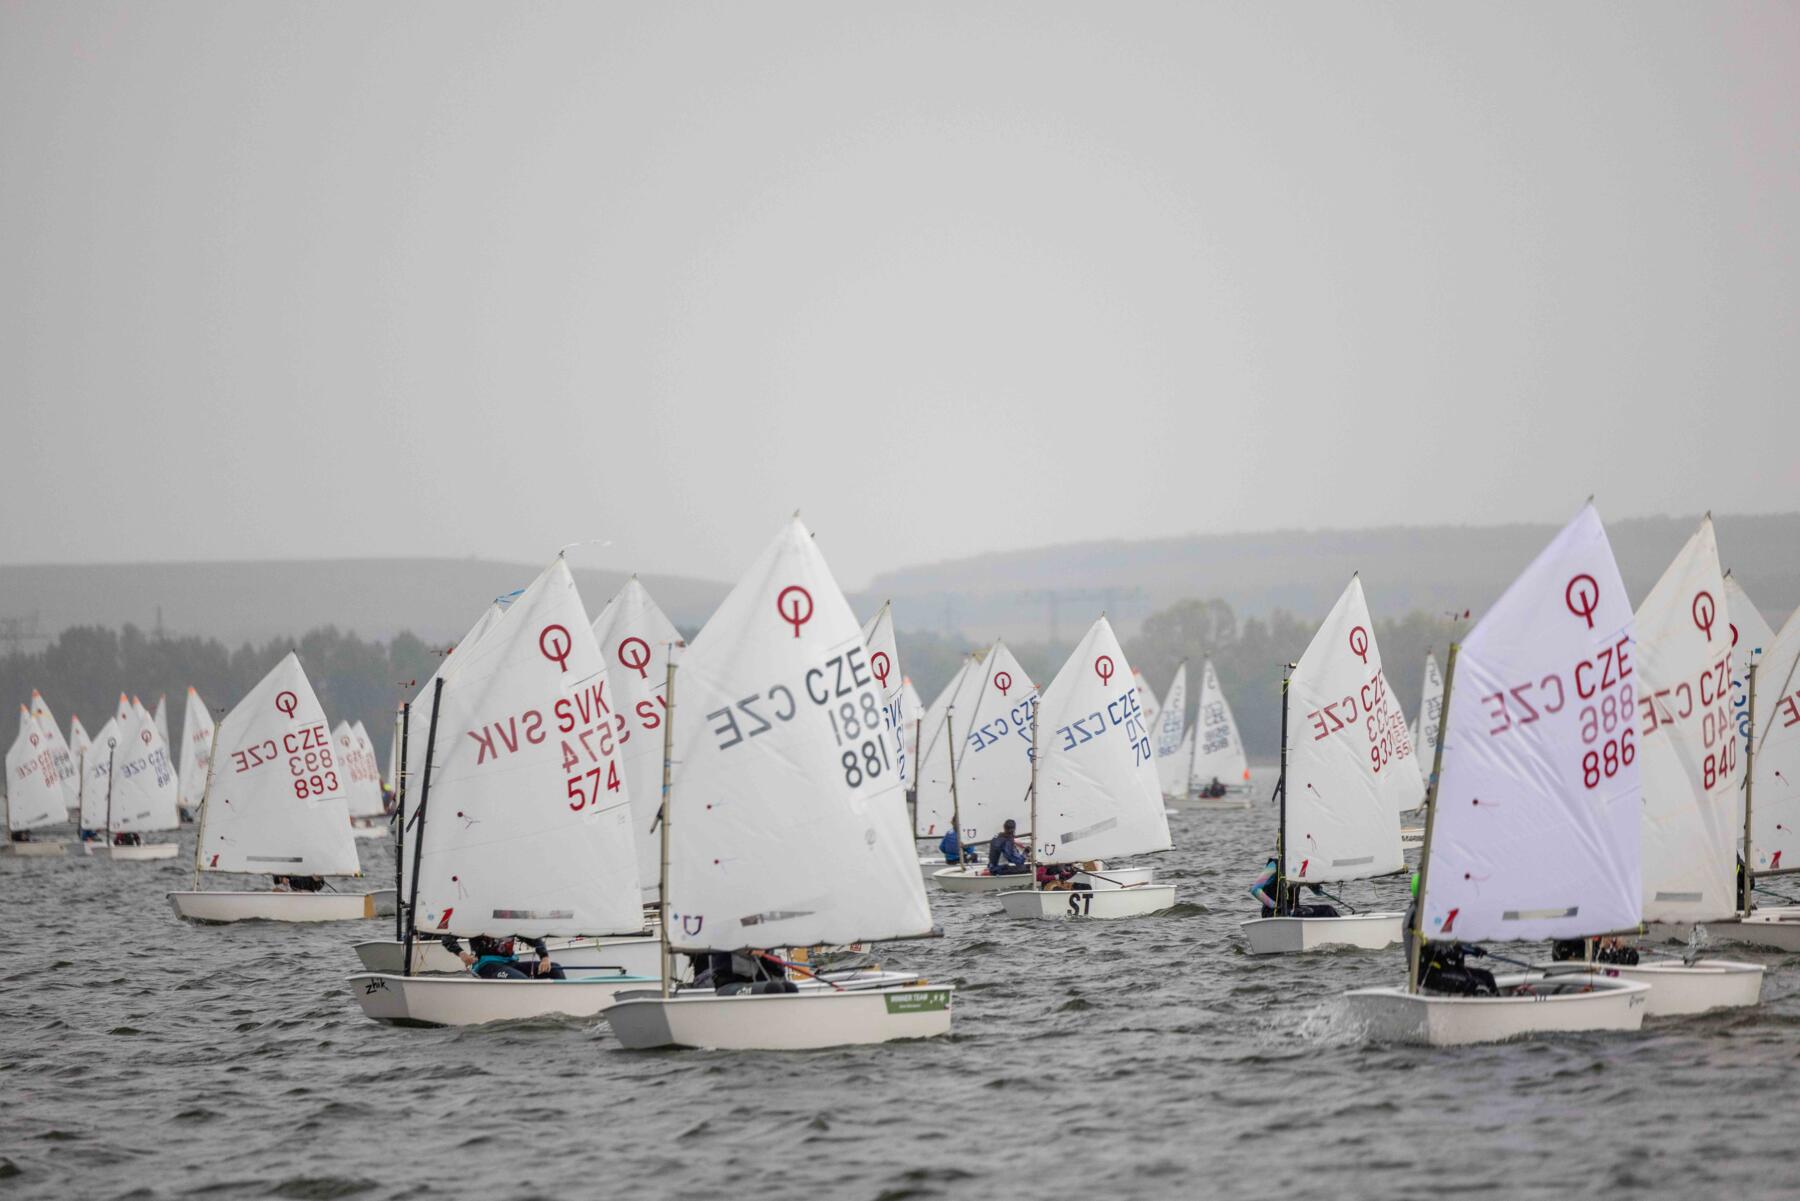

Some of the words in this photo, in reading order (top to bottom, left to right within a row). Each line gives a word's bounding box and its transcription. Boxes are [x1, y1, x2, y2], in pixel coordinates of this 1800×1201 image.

[805, 646, 871, 706] CZE
[1361, 668, 1386, 713] CZE
[1574, 636, 1633, 700] CZE
[1700, 651, 1734, 706] CZE
[553, 680, 610, 733] SVK
[1107, 688, 1140, 726] CZE
[283, 725, 329, 754] CZE
[841, 733, 890, 789] 881
[1131, 736, 1152, 767] 70
[1371, 730, 1393, 773] 933
[1582, 728, 1635, 790] 886
[1703, 735, 1736, 791] 840
[294, 771, 339, 799] 893
[567, 760, 621, 812] 574
[1067, 893, 1094, 916] ST
[365, 977, 390, 996] zhik
